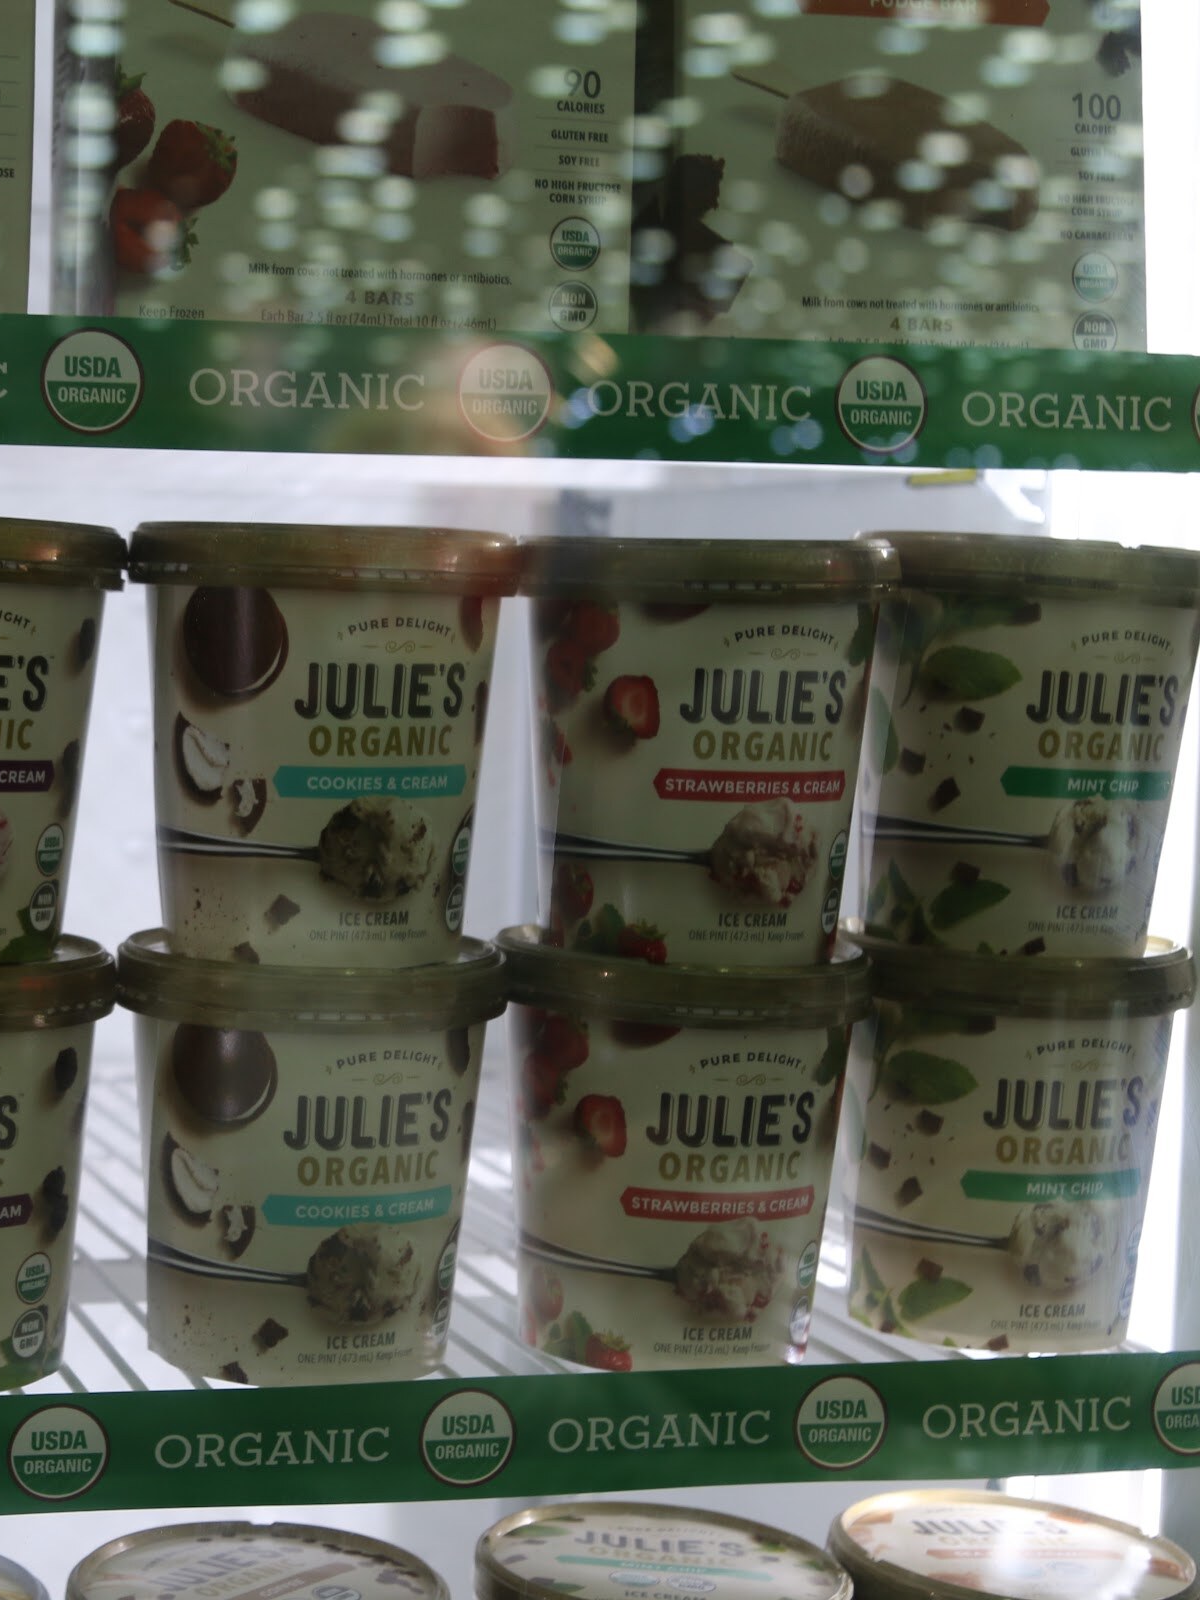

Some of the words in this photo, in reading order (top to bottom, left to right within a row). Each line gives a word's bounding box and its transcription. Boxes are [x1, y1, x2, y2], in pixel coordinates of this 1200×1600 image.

[564, 69, 601, 99] 90
[1072, 92, 1121, 122] 100
[64, 355, 121, 380] USDA
[479, 366, 533, 391] USDA
[58, 385, 127, 405] ORGANIC
[189, 367, 425, 410] ORGANIC
[587, 378, 811, 422] ORGANIC
[856, 379, 907, 401] USDA
[471, 398, 537, 417] ORGANIC
[850, 406, 912, 427] ORGANIC
[962, 390, 1172, 432] ORGANIC
[295, 662, 466, 720] JULIE'S
[680, 668, 846, 725] JULIE'S
[1026, 670, 1179, 726] JULIE'S
[308, 724, 453, 757] ORGANIC
[693, 729, 833, 762] ORGANIC
[1038, 729, 1164, 761] ORGANIC
[307, 776, 382, 790] COOKIES
[387, 777, 396, 790] &
[401, 775, 448, 789] CREAM
[665, 778, 789, 795] STRAWBERRIES
[792, 782, 801, 794] &
[804, 780, 841, 794] CREAM
[1068, 779, 1106, 792] MINT
[1110, 780, 1139, 793] CHIP
[339, 912, 361, 926] ICE
[365, 911, 409, 926] CREAM
[719, 913, 741, 927] ICE
[745, 913, 787, 927] CREAM
[983, 1076, 1143, 1131] JULIE'S
[283, 1089, 451, 1150] JULIE'S
[646, 1091, 815, 1148] JULIE'S
[996, 1133, 1131, 1165] ORGANIC
[297, 1150, 440, 1187] ORGANIC
[658, 1151, 801, 1183] ORGANIC
[1027, 1182, 1067, 1195] MINT
[1071, 1181, 1104, 1194] CHIP
[296, 1204, 370, 1219] COOKIES
[375, 1203, 384, 1216] &
[388, 1199, 434, 1216] CREAM
[632, 1196, 754, 1214] STRAWBERRIES
[758, 1200, 767, 1213] &
[770, 1194, 809, 1211] CREAM
[327, 1335, 348, 1350] ICE
[352, 1331, 396, 1348] CREAM
[683, 1327, 705, 1341] ICE
[708, 1327, 753, 1341] CREAM
[815, 1398, 868, 1420] USDA
[923, 1396, 1131, 1440] ORGANIC
[442, 1414, 495, 1436] USDA
[549, 1410, 770, 1453] ORGANIC
[809, 1426, 872, 1444] ORGANIC
[31, 1430, 88, 1451] USDA
[154, 1427, 390, 1469] ORGANIC
[435, 1441, 500, 1460] ORGANIC
[23, 1457, 92, 1475] ORGANIC
